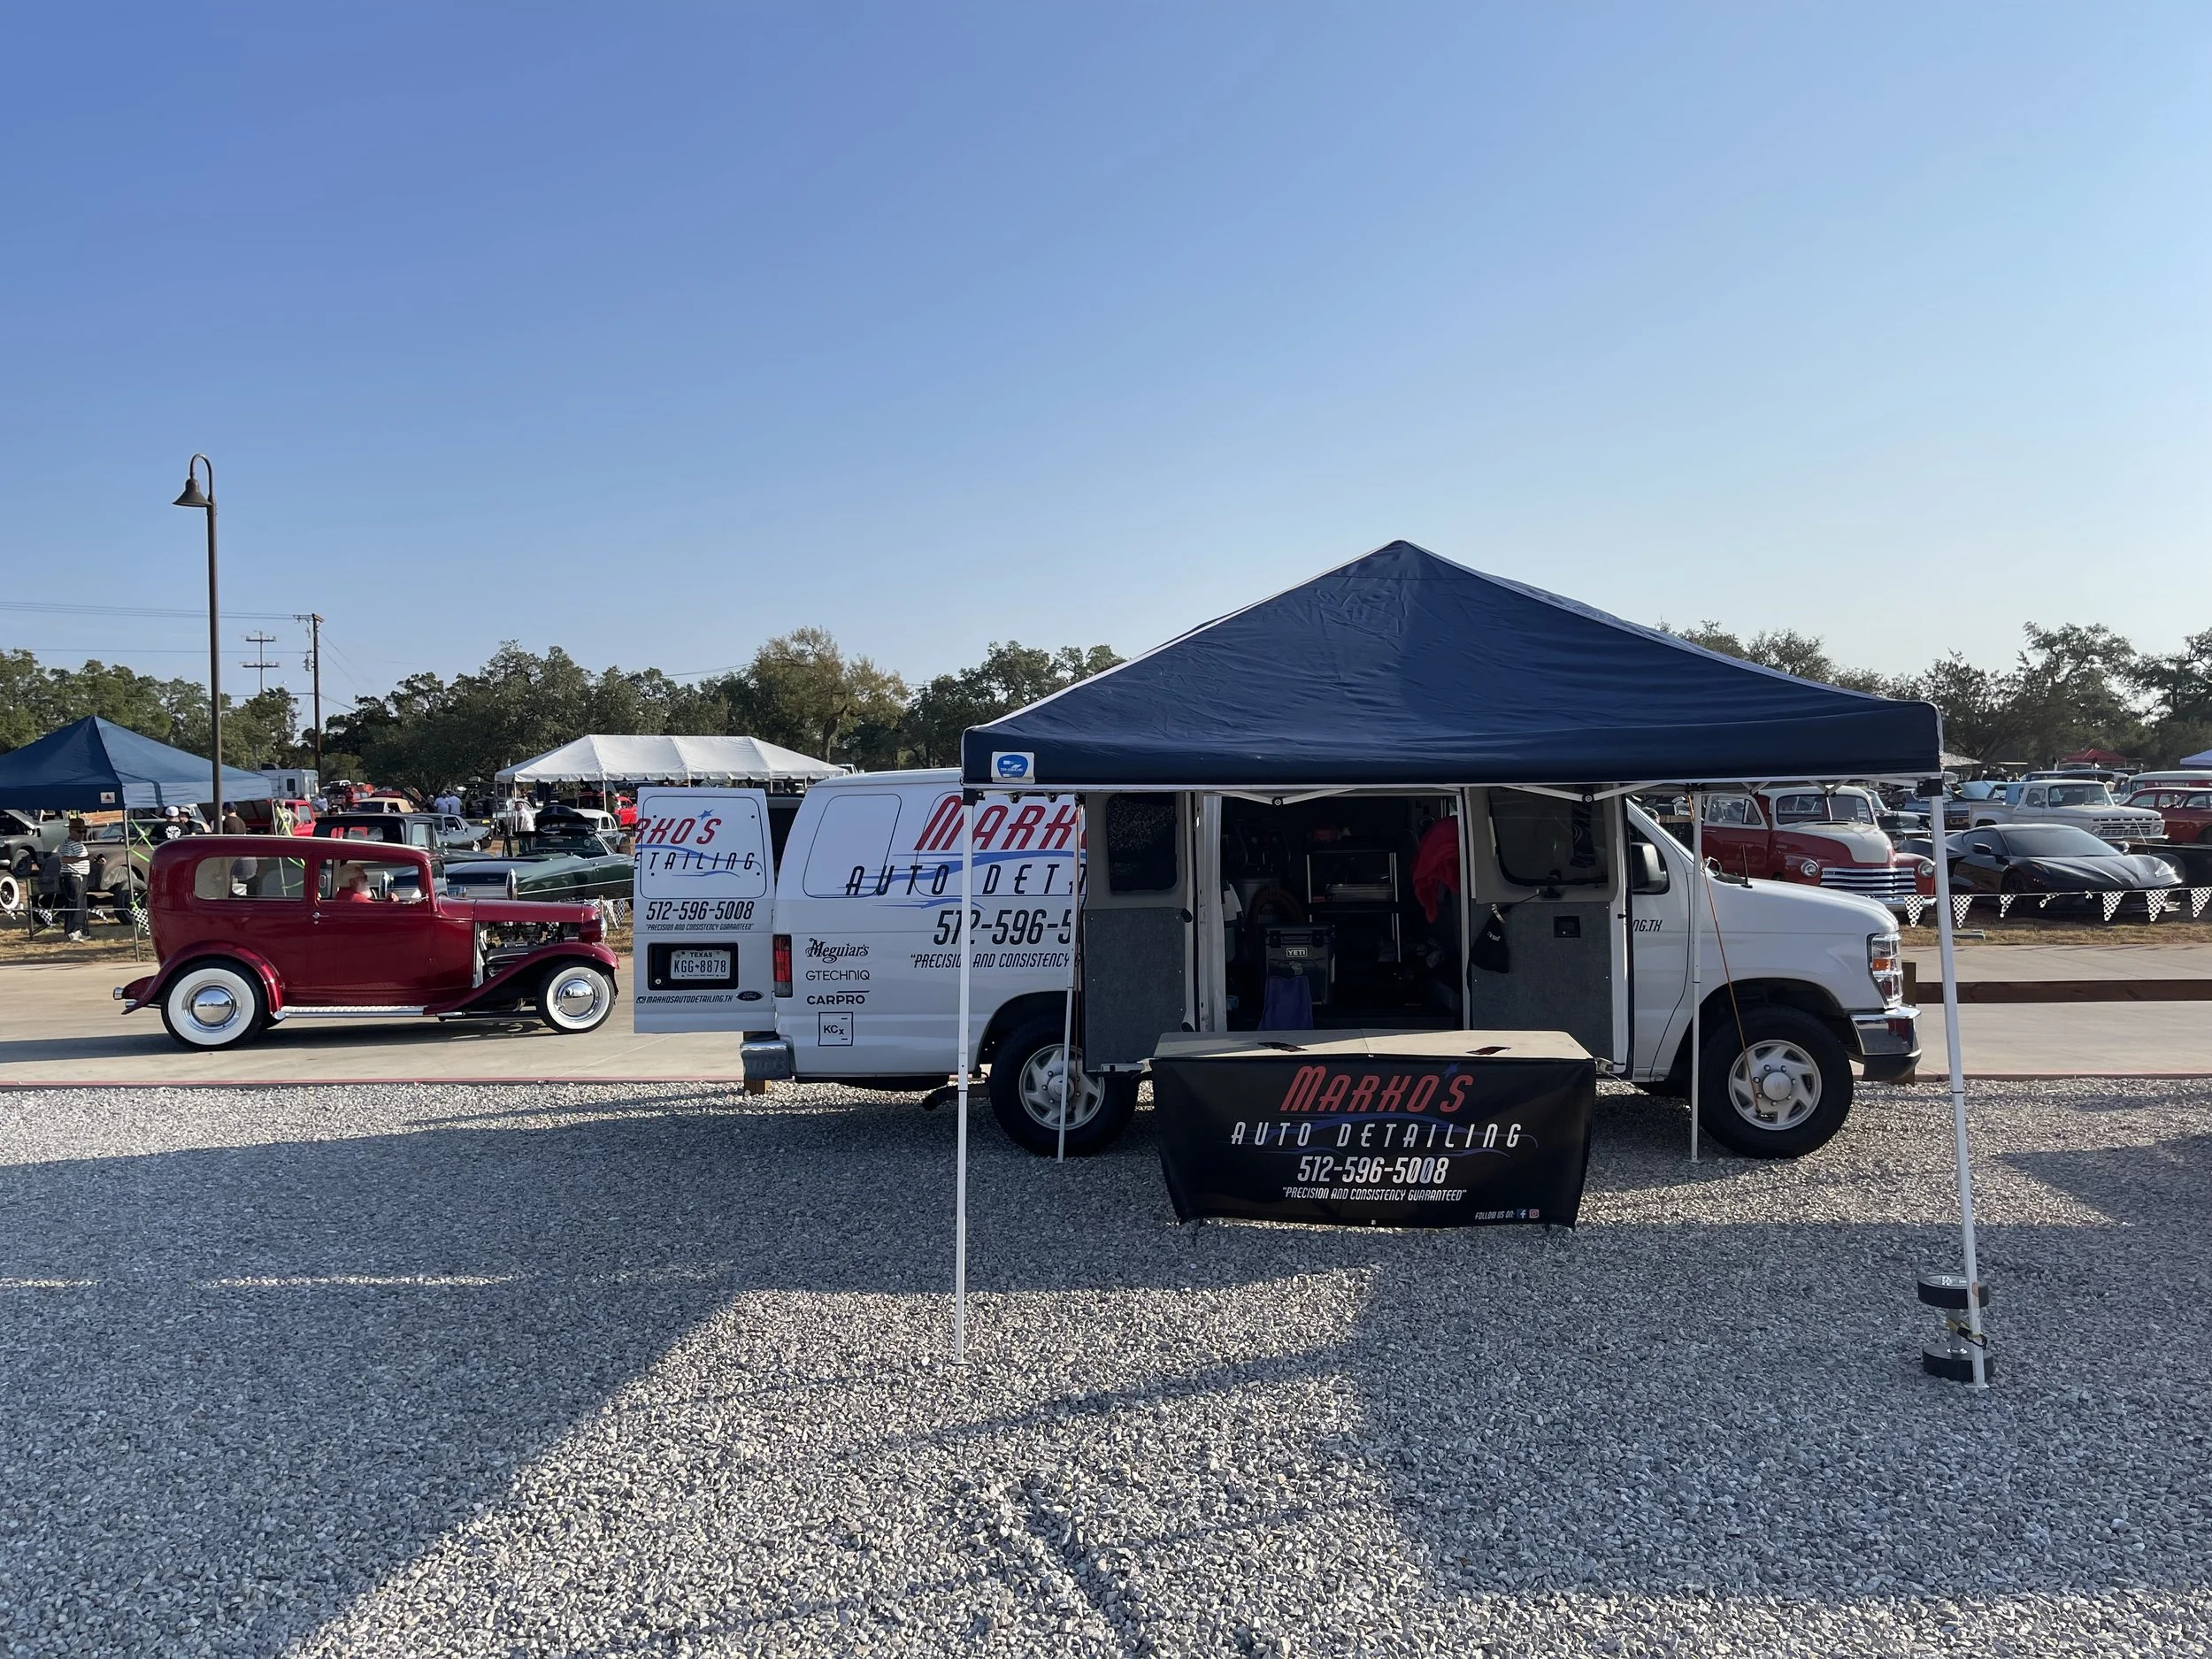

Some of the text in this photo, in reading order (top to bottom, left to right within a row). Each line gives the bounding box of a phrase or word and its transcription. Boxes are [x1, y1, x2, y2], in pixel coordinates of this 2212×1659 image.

[913, 795, 1087, 851] MARK
[845, 864, 950, 896] AUTO
[646, 901, 755, 920] 512-596-5008
[805, 937, 870, 964] Meguiar's
[972, 952, 995, 968] AND
[998, 952, 1070, 968] CONSISTENCY
[805, 970, 870, 980] GTECHNIQ
[806, 995, 865, 1005] CARPRO
[1231, 1122, 1522, 1148] AUTO DETAILING
[1297, 1156, 1450, 1184] 512-596-5008
[1330, 1187, 1348, 1200] AND
[1349, 1188, 1406, 1201] CONSISTENCY
[1475, 1210, 1497, 1220] FOLLOW
